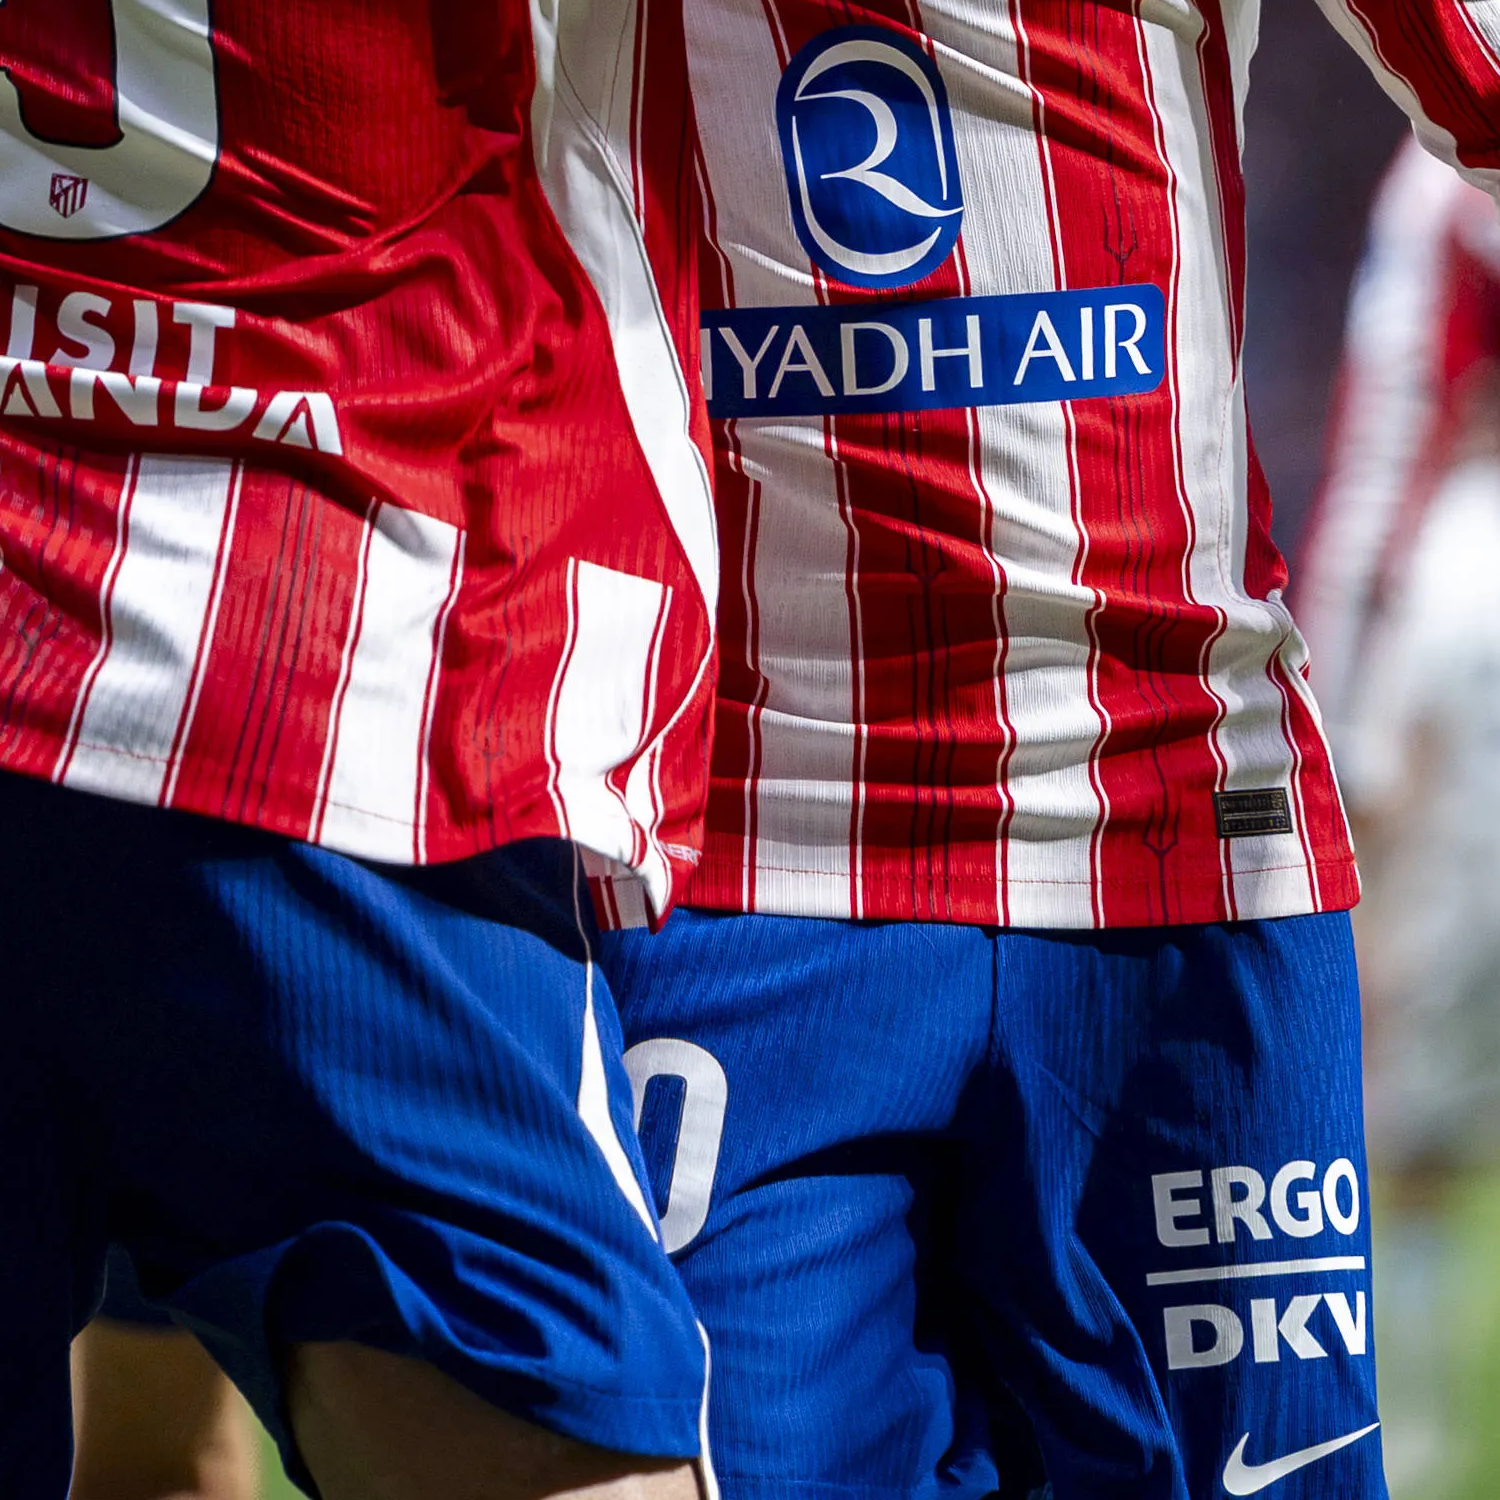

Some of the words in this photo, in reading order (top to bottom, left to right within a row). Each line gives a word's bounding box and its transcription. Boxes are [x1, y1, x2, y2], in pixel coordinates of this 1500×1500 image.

[1013, 303, 1153, 386] AIR
[1151, 1157, 1360, 1248] ERGO
[1162, 1290, 1367, 1370] DKV
